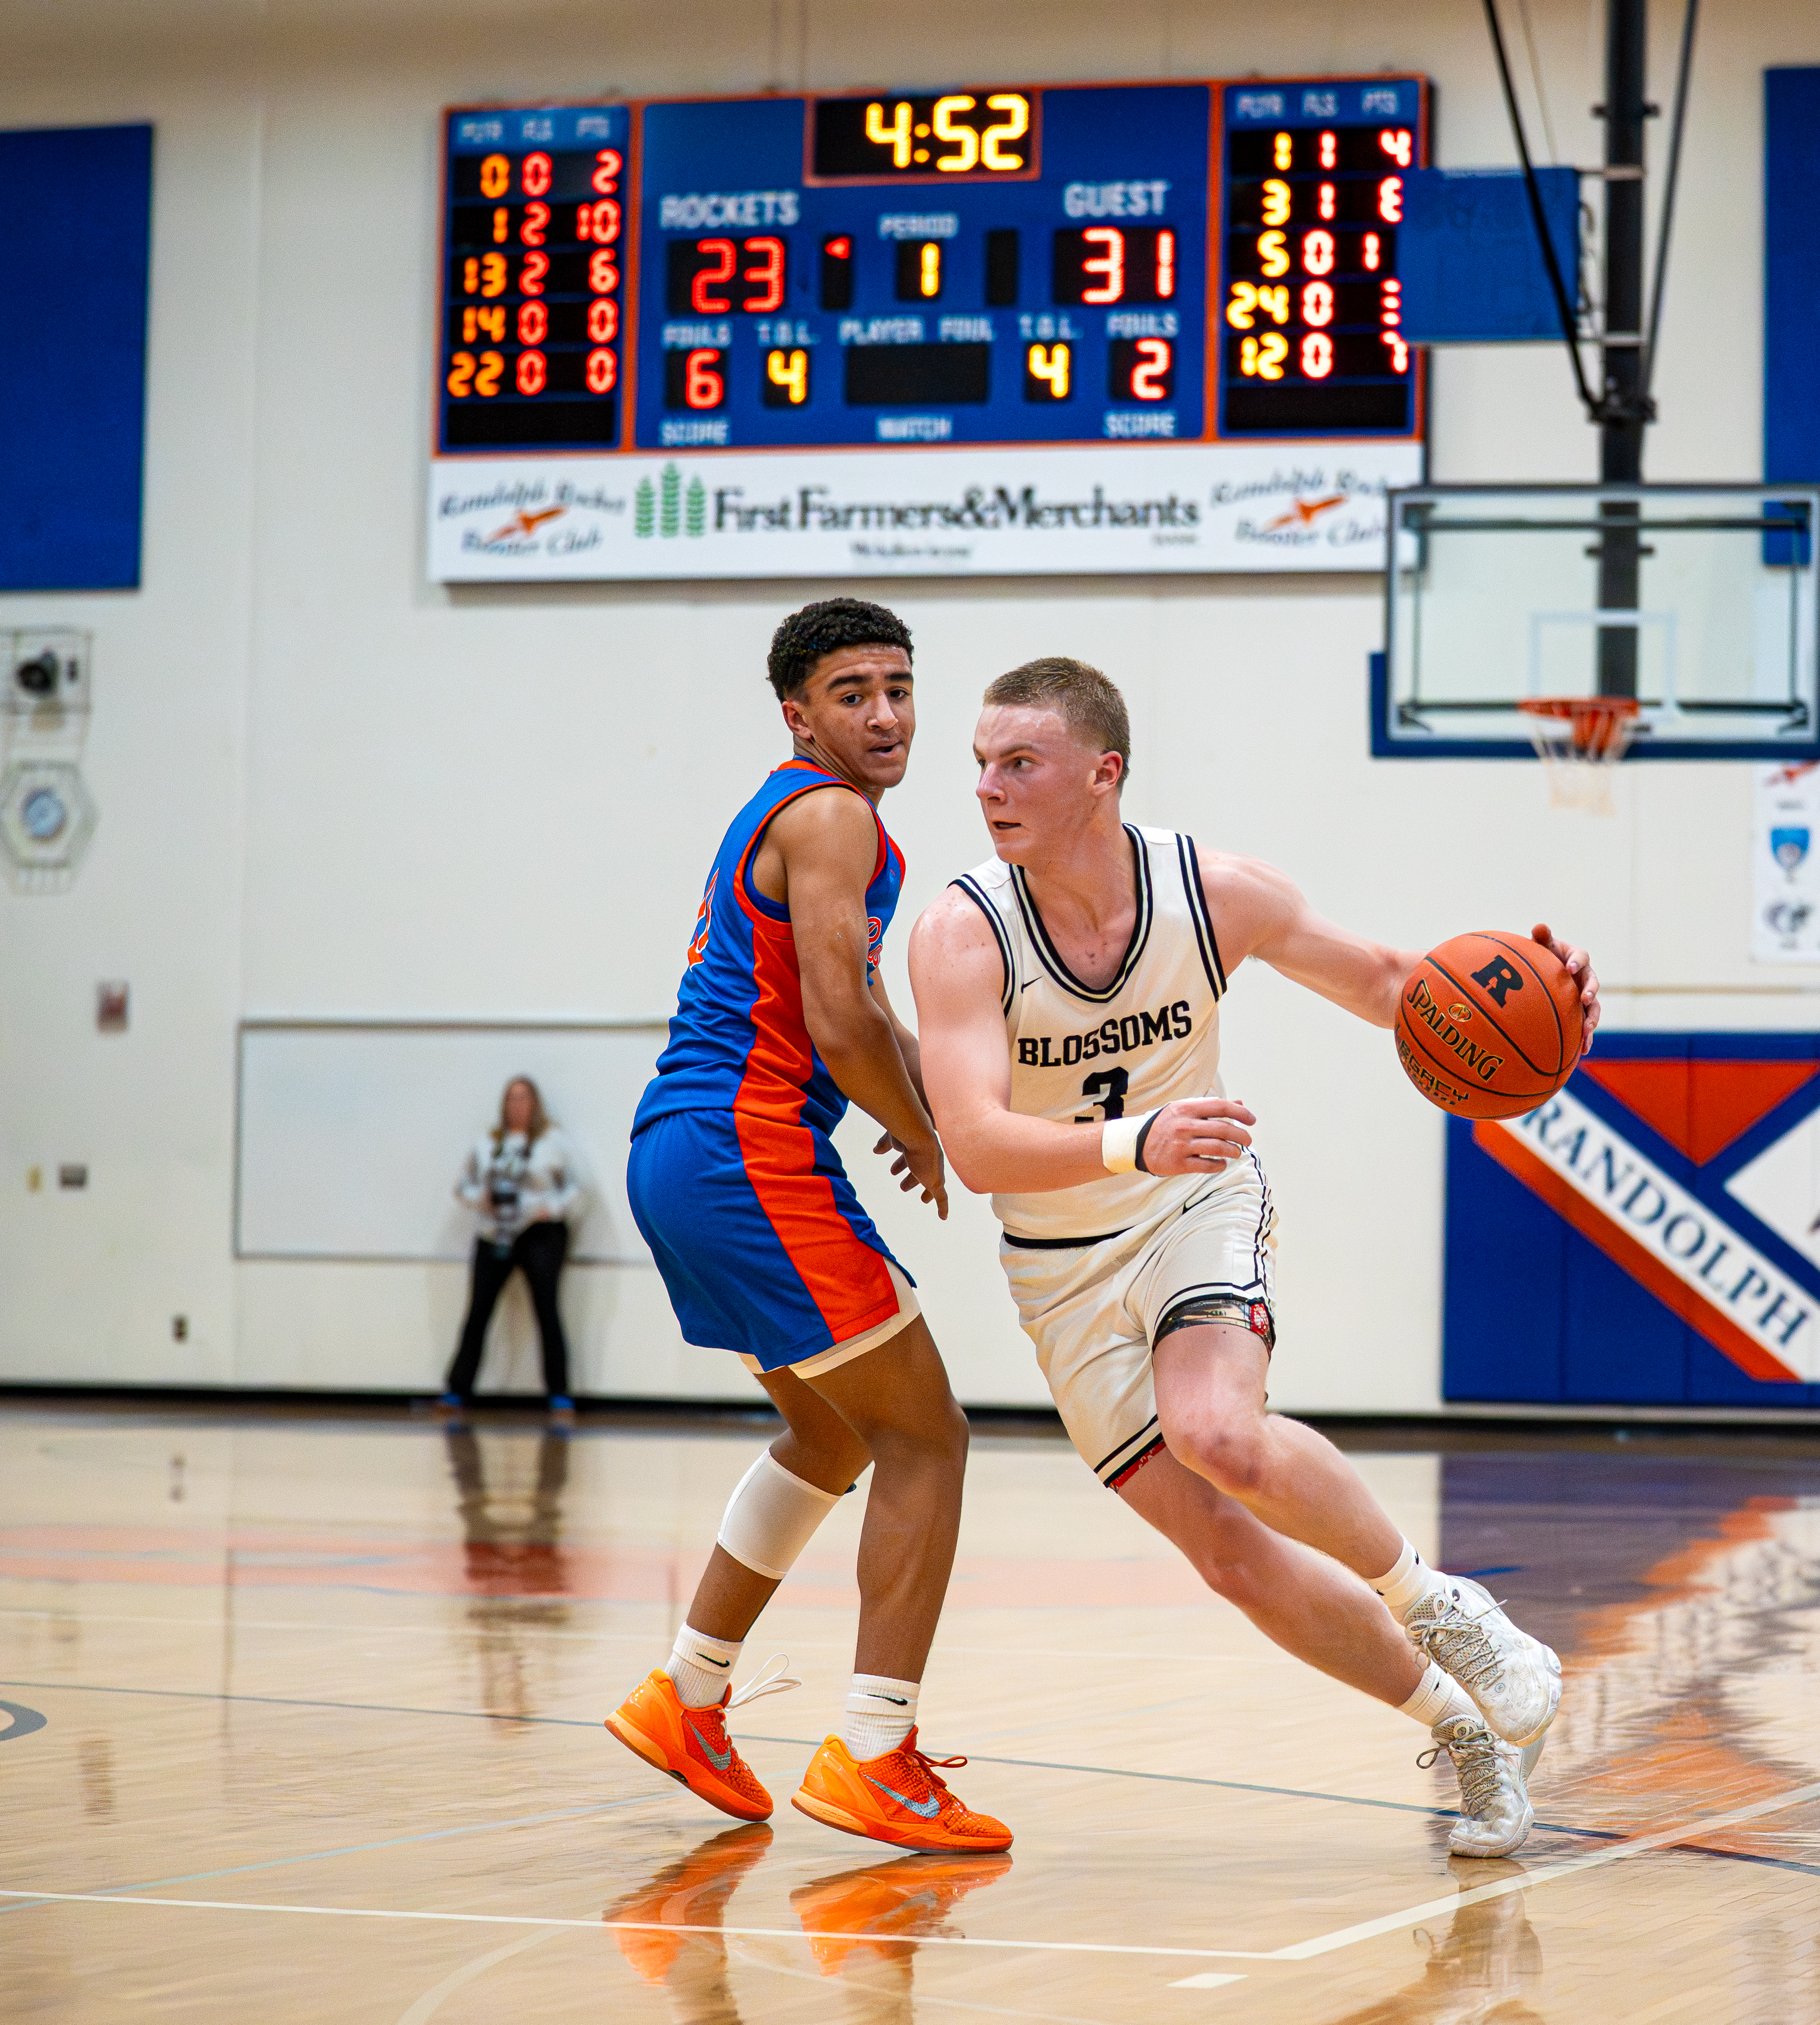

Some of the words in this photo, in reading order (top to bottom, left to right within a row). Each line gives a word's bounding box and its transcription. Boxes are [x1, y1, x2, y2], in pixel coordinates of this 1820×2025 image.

[865, 93, 1030, 173] 4:52
[1273, 132, 1292, 171] 1
[1318, 130, 1337, 170] 1
[1378, 128, 1413, 168] 4
[480, 154, 510, 198] 0
[521, 151, 552, 197] 0
[592, 149, 623, 195] 2
[493, 207, 508, 243] 1
[520, 201, 551, 246] 2
[576, 198, 621, 244] 10
[659, 191, 800, 229] ROCKETS
[1064, 180, 1170, 218] GUEST
[1261, 179, 1292, 226] 3
[1317, 182, 1336, 221] 1
[879, 214, 959, 239] PERIOD
[464, 252, 507, 298] 13
[519, 250, 550, 296] 2
[588, 248, 620, 294] 6
[691, 236, 785, 314] 23
[920, 242, 940, 297] 1
[1081, 226, 1175, 305] 31
[1257, 230, 1290, 278] 5
[1301, 228, 1336, 277] 0
[463, 305, 506, 344] 14
[517, 299, 548, 346] 0
[587, 297, 619, 344] 0
[839, 315, 924, 344] PLAYER
[939, 314, 995, 341] FOUL
[1107, 312, 1178, 339] FOULS
[1225, 281, 1290, 331] 24
[1300, 280, 1335, 328] 0
[663, 321, 732, 347] FOULS
[1240, 332, 1289, 381] 12
[1299, 331, 1334, 380] 0
[447, 350, 504, 397] 22
[516, 349, 547, 396] 0
[586, 347, 617, 394] 0
[685, 347, 724, 410] 6
[767, 349, 808, 404] 4
[1028, 343, 1070, 399] 4
[1130, 337, 1171, 401] 2
[1471, 954, 1524, 1008] R
[1017, 1000, 1192, 1067] BLOSSOMS
[1407, 978, 1504, 1082] SPALDING
[1074, 1066, 1129, 1124] 3
[1522, 1096, 1809, 1348] RANDOLPH
